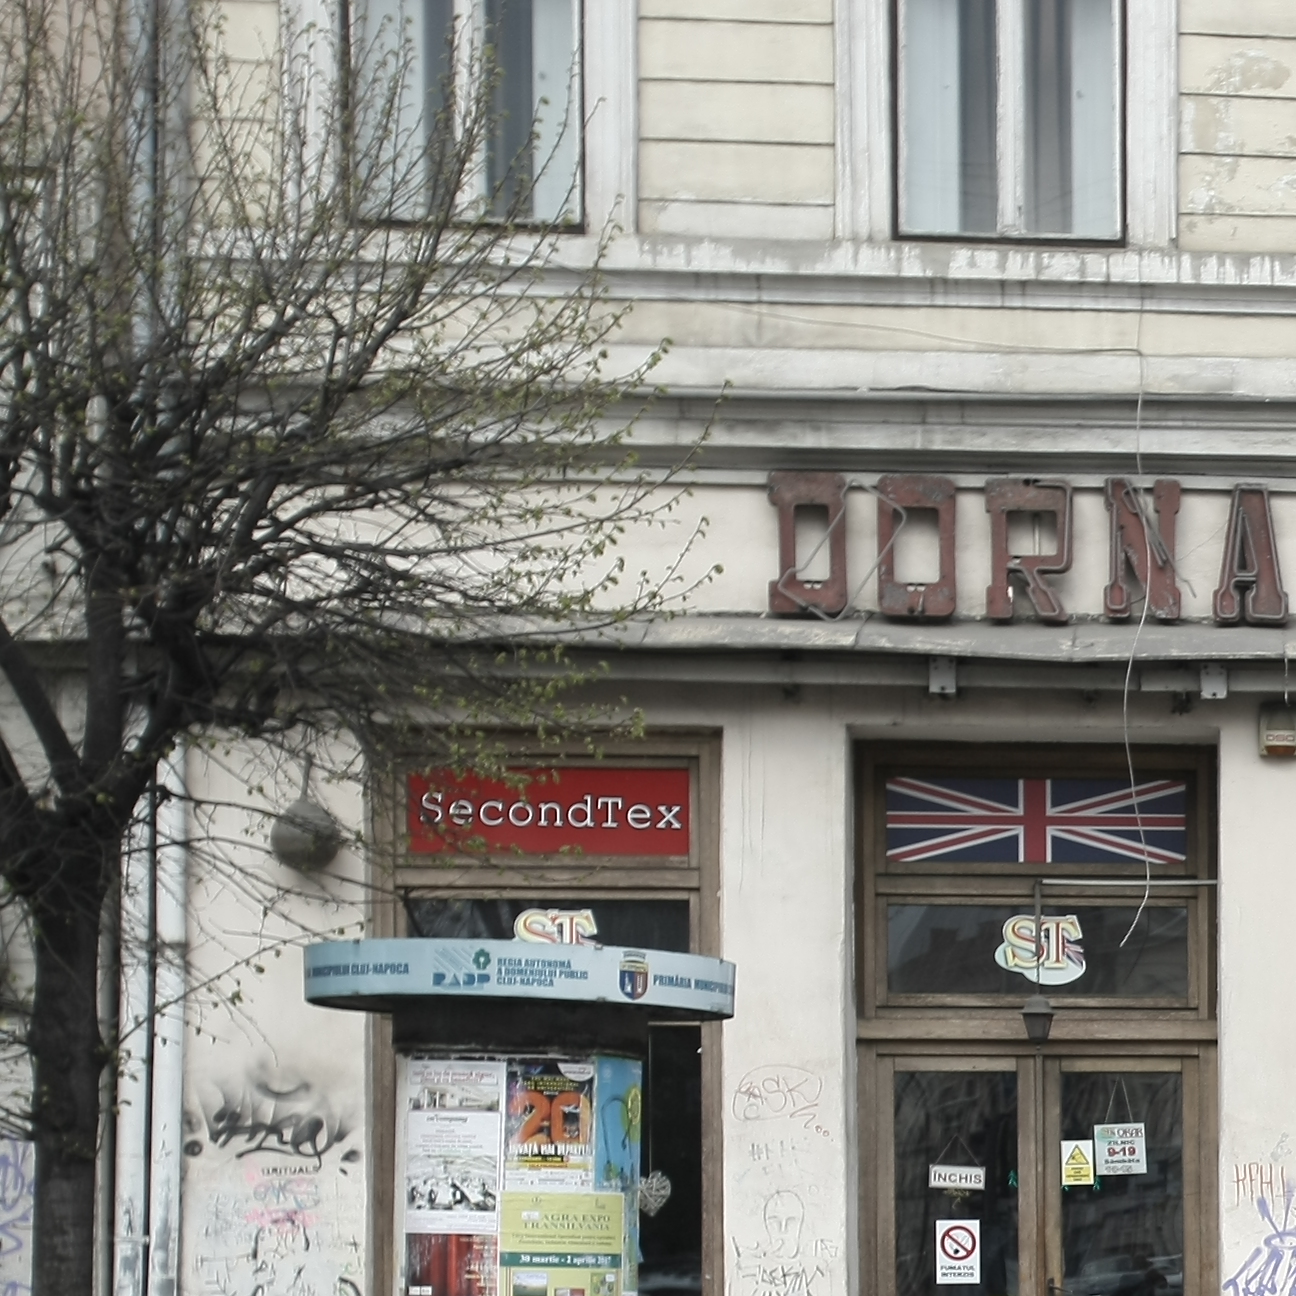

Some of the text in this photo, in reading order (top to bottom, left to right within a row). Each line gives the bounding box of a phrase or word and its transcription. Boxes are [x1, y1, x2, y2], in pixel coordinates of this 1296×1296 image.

[419, 792, 682, 830] SecondTex
[1004, 916, 1082, 969] ST
[497, 957, 523, 967] REGIA
[350, 963, 410, 975] CLUJ-NAPOCA
[559, 970, 588, 980] PUBLIC
[497, 977, 554, 987] CLUJ-NAPOCA
[1107, 1146, 1136, 1157] 9-19
[542, 1214, 579, 1222] AGRA
[524, 1222, 611, 1231] TRANSILVANIA
[532, 1255, 560, 1264] martie
